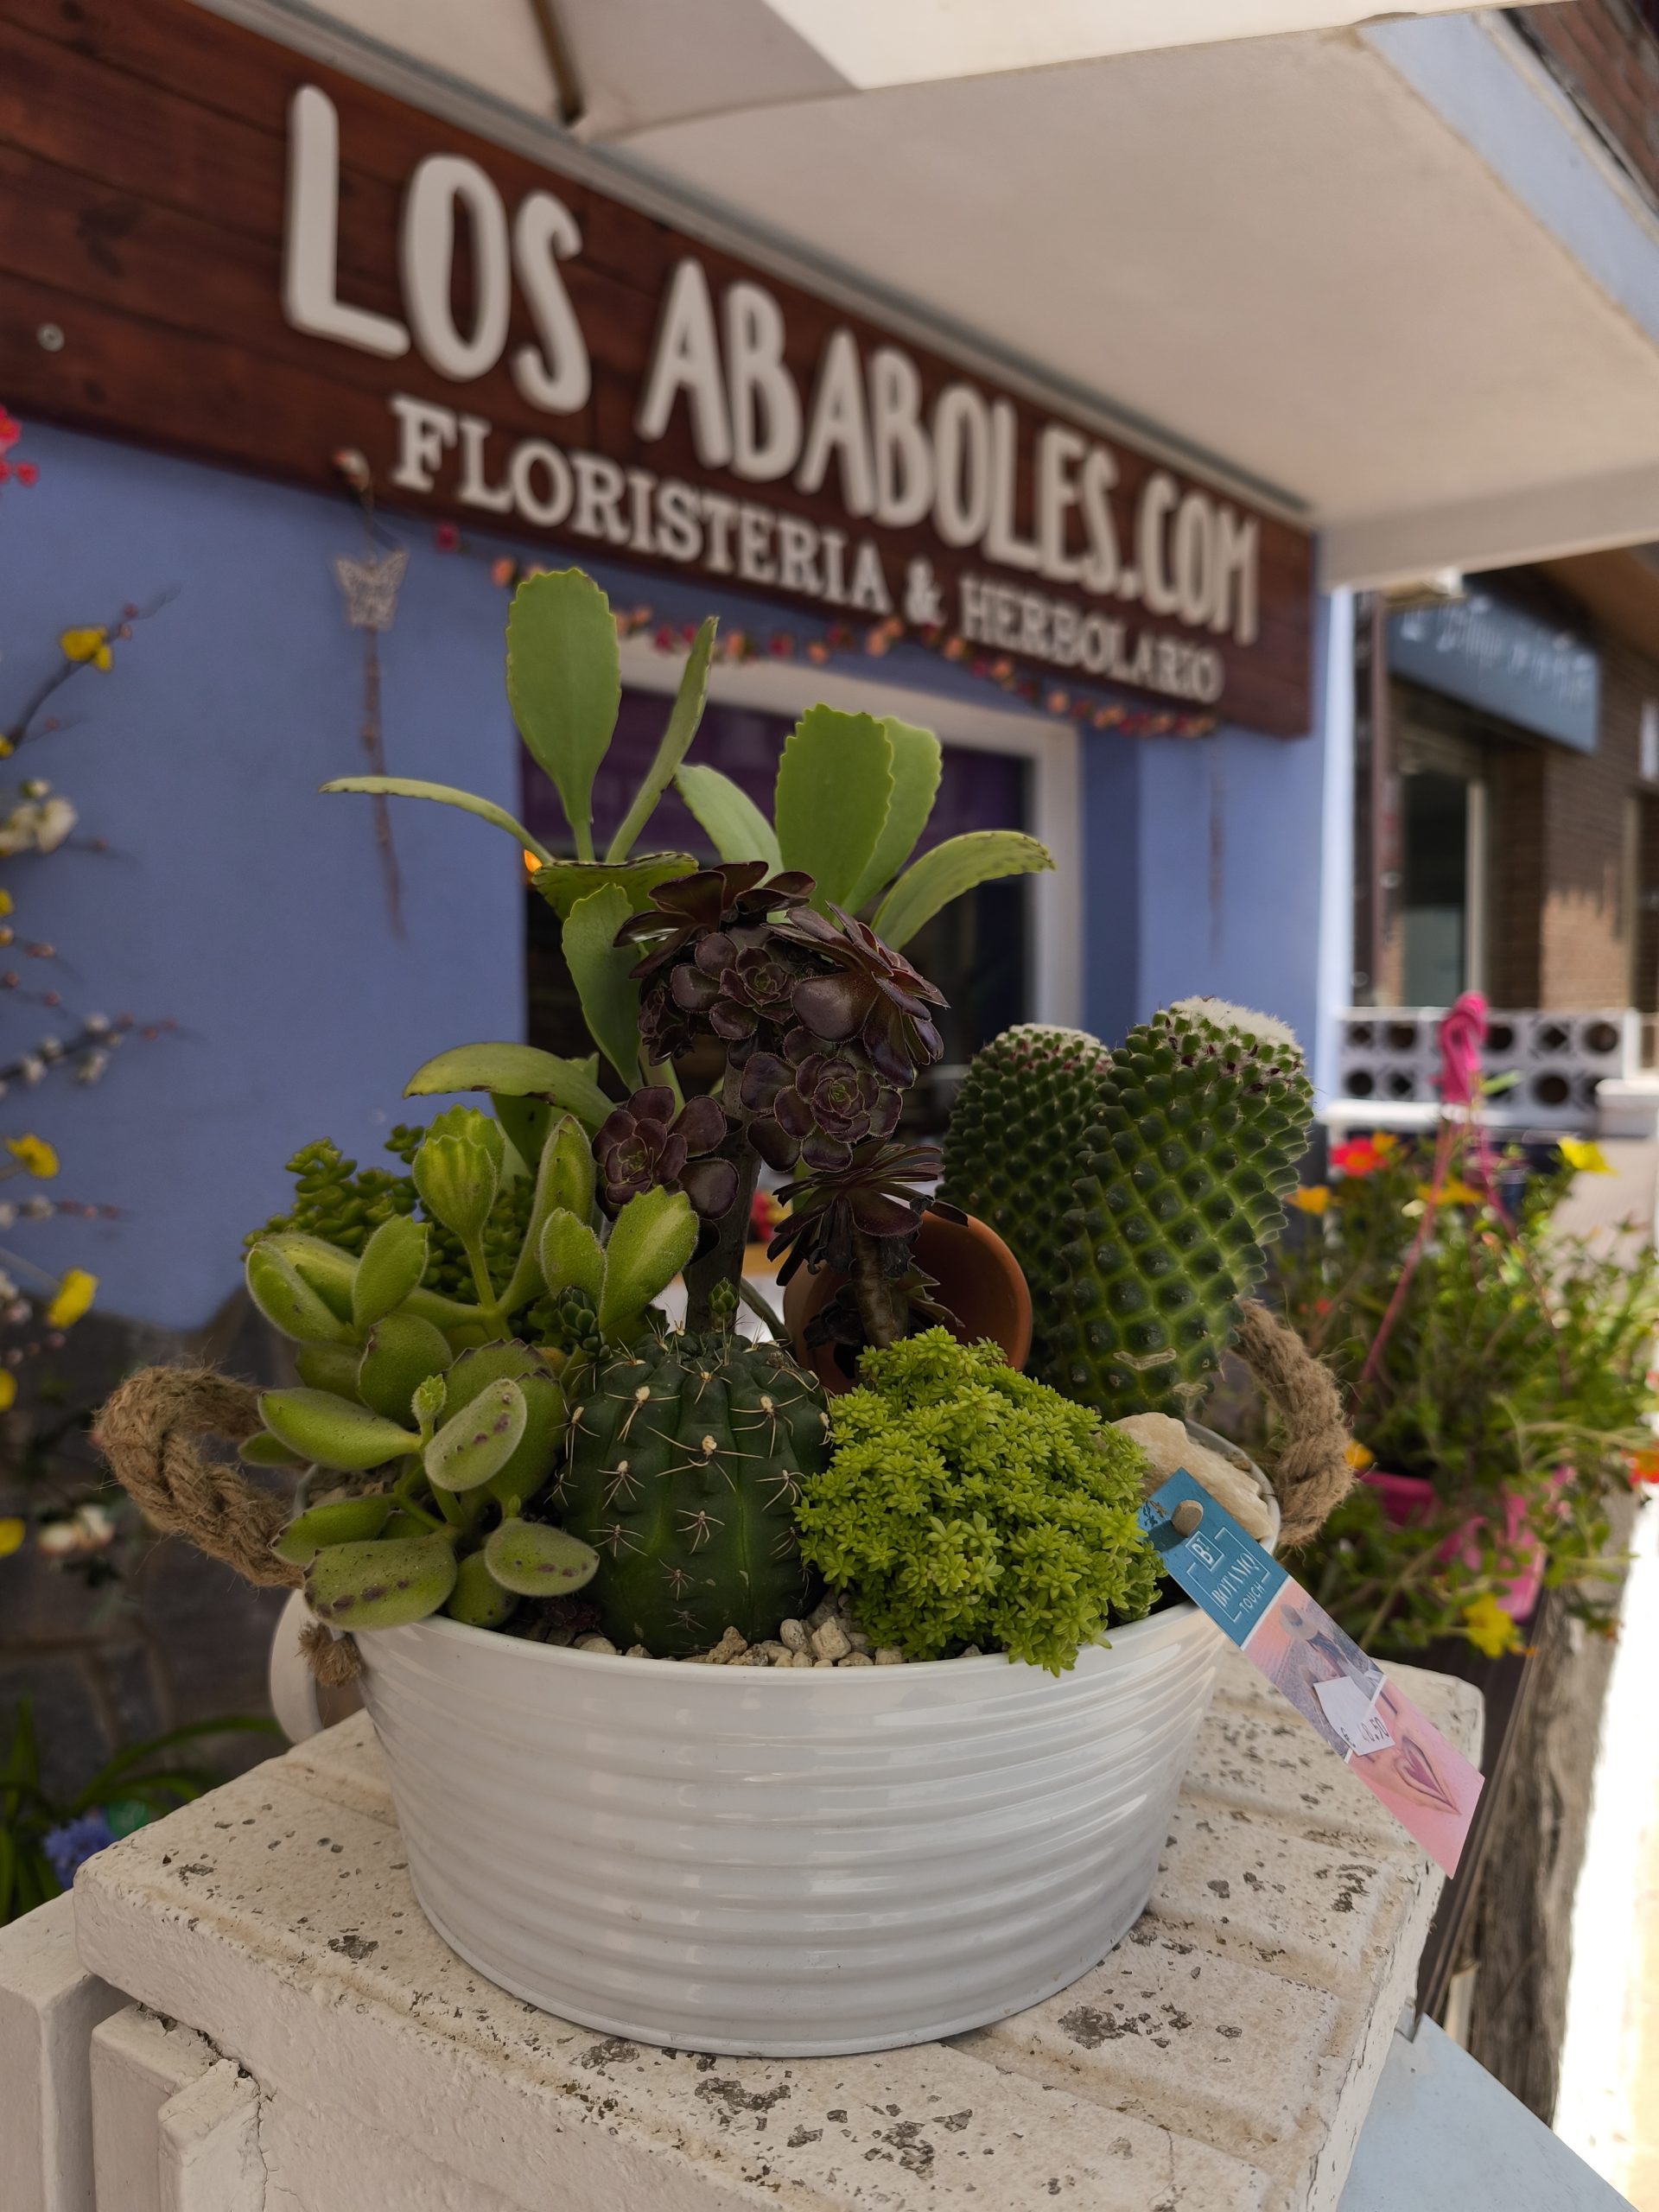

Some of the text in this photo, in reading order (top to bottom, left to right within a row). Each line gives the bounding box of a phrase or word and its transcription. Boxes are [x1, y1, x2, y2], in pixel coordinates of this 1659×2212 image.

[283, 84, 1258, 646] LOS ABABOLES.COM
[390, 394, 1222, 704] FLORISTERIA & HERBOLARIO
[1211, 1552, 1261, 1608] BOTANIQ
[1238, 1580, 1266, 1614] TOUCH
